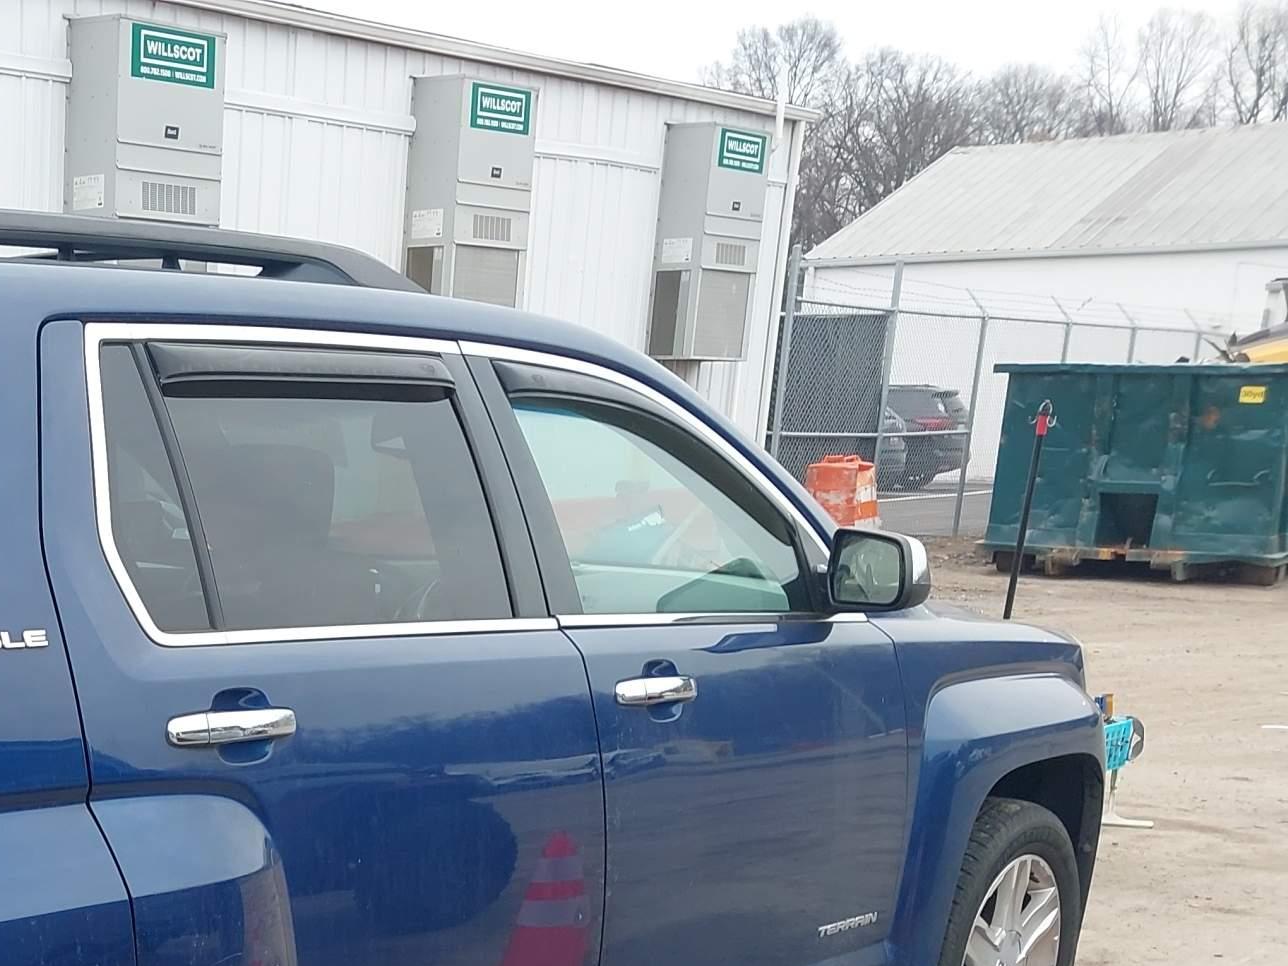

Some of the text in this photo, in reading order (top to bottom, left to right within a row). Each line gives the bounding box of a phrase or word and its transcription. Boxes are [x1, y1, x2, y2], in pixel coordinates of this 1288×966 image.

[146, 39, 202, 62] WILLSCOT
[482, 95, 522, 114] WILLSCOT
[727, 139, 759, 156] WILLSCOT
[818, 911, 878, 938] TERRAIN
